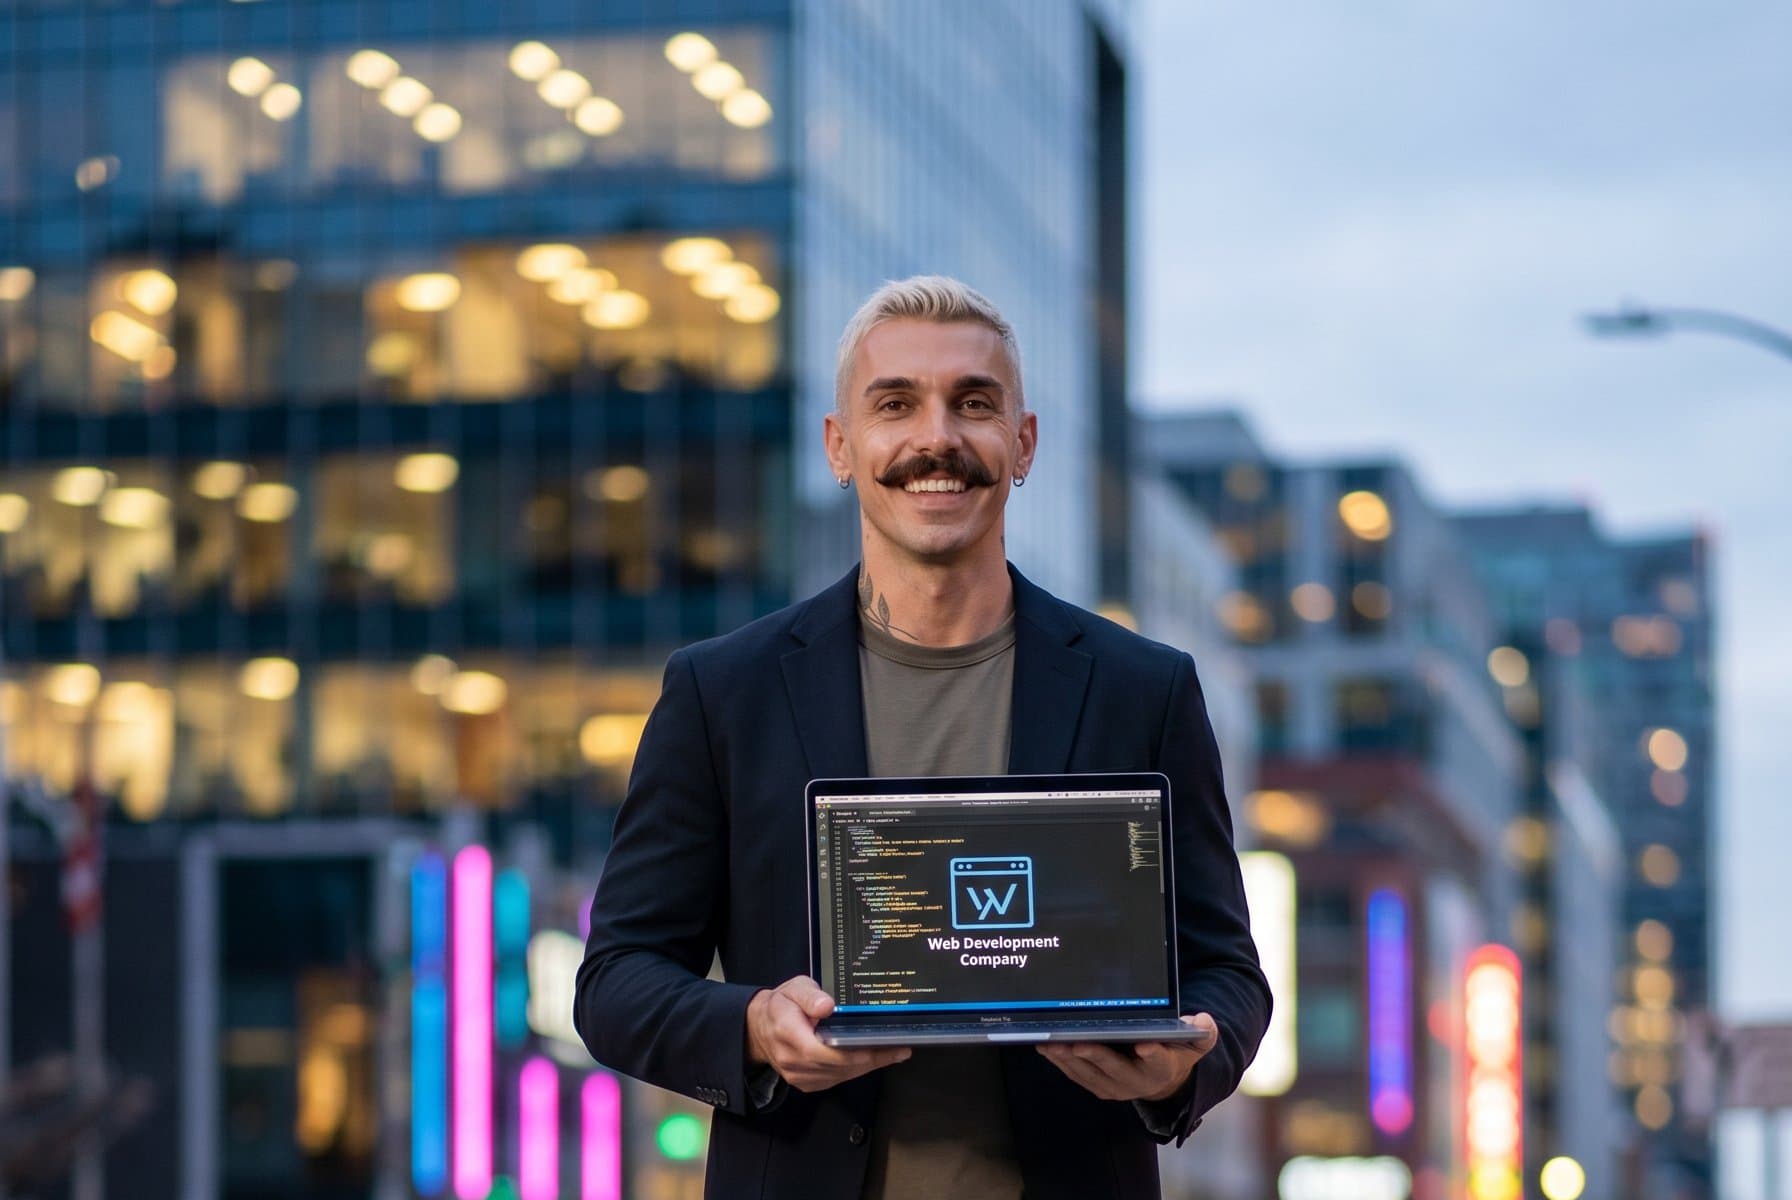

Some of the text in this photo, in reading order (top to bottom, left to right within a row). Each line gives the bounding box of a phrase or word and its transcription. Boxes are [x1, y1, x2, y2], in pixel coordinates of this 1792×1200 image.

[928, 936, 1060, 951] Web Development
[960, 954, 1028, 968] Company
